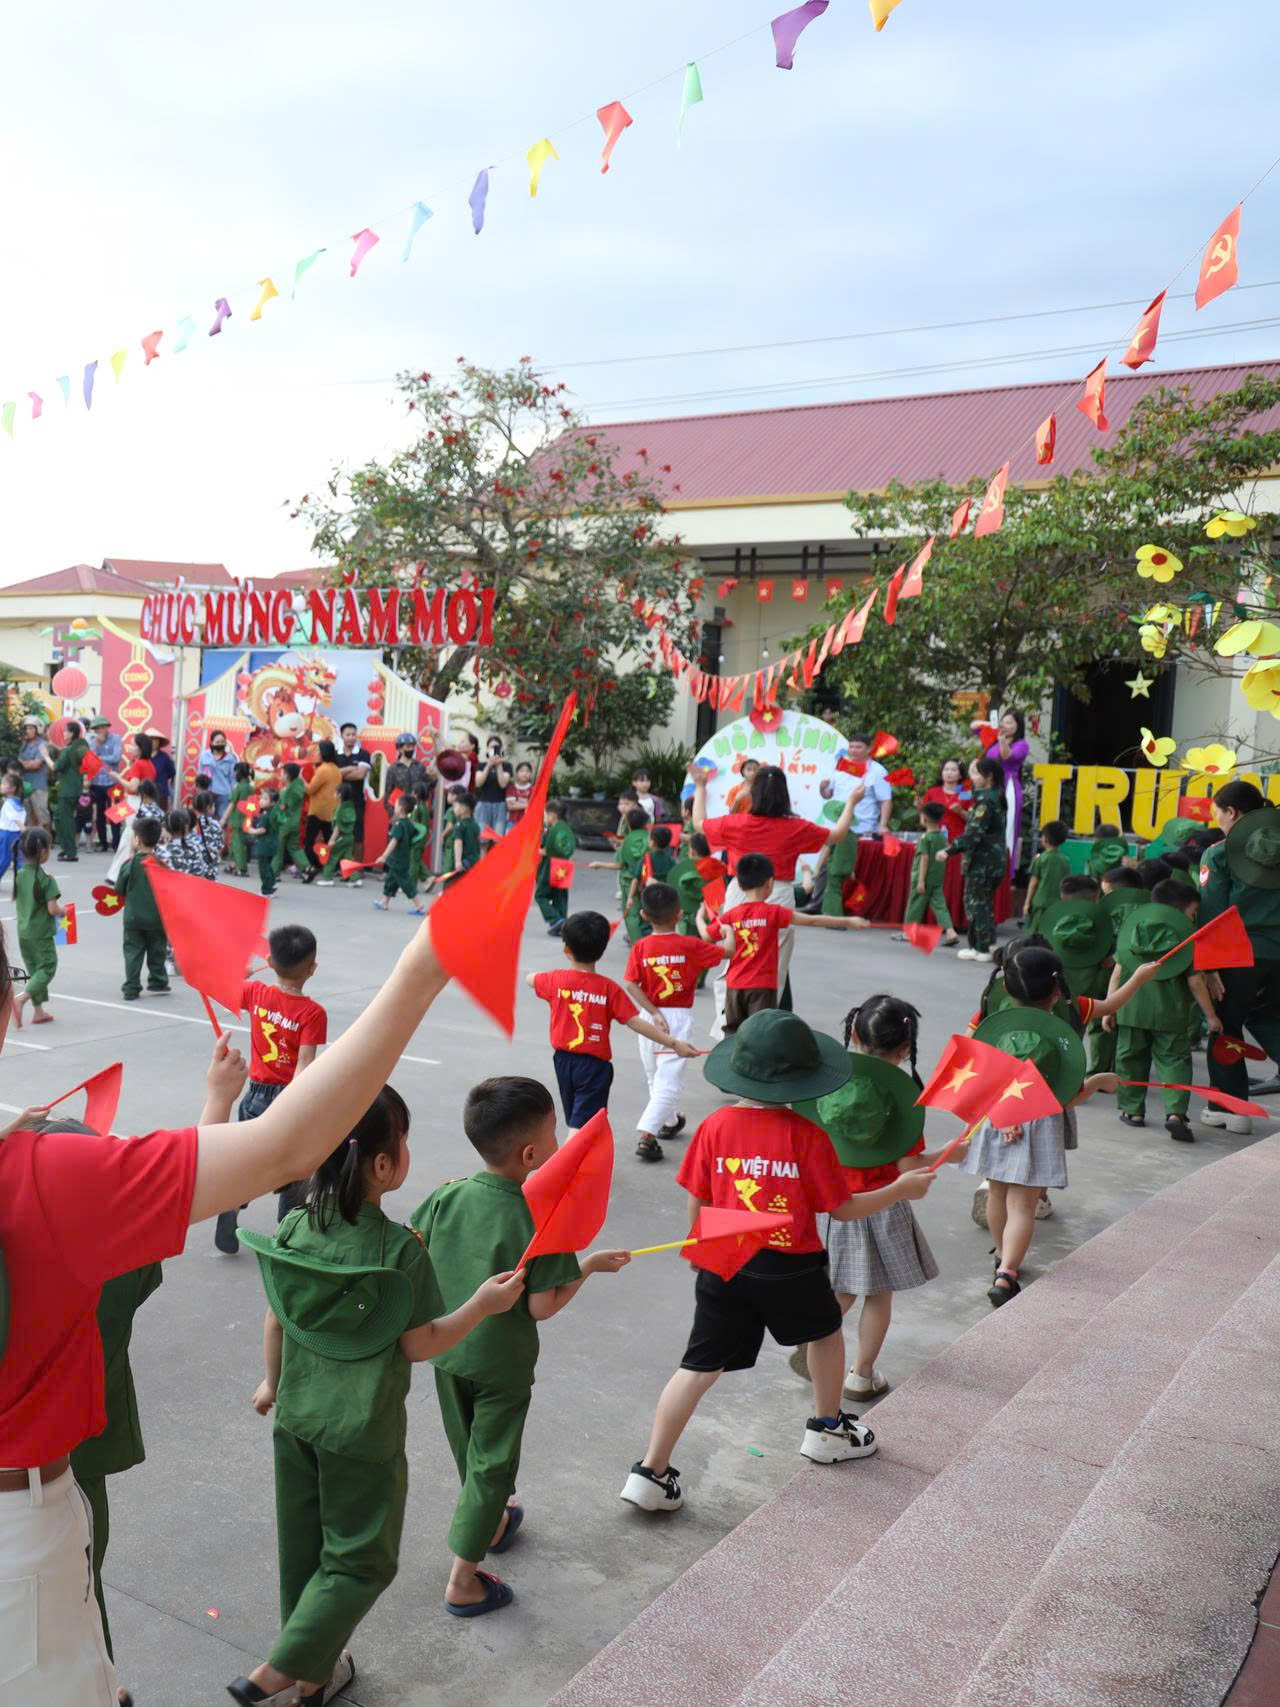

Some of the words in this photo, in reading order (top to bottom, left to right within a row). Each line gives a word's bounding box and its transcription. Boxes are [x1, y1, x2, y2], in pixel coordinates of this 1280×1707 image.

[139, 575, 198, 645] CHÚC
[203, 576, 296, 647] MỪNG
[308, 566, 404, 647] NĂM
[411, 567, 495, 646] MỚI
[571, 989, 589, 1003] VIỆT
[588, 993, 608, 1006] NAM
[716, 1157, 723, 1174] I
[740, 1155, 770, 1179] VIỆT
